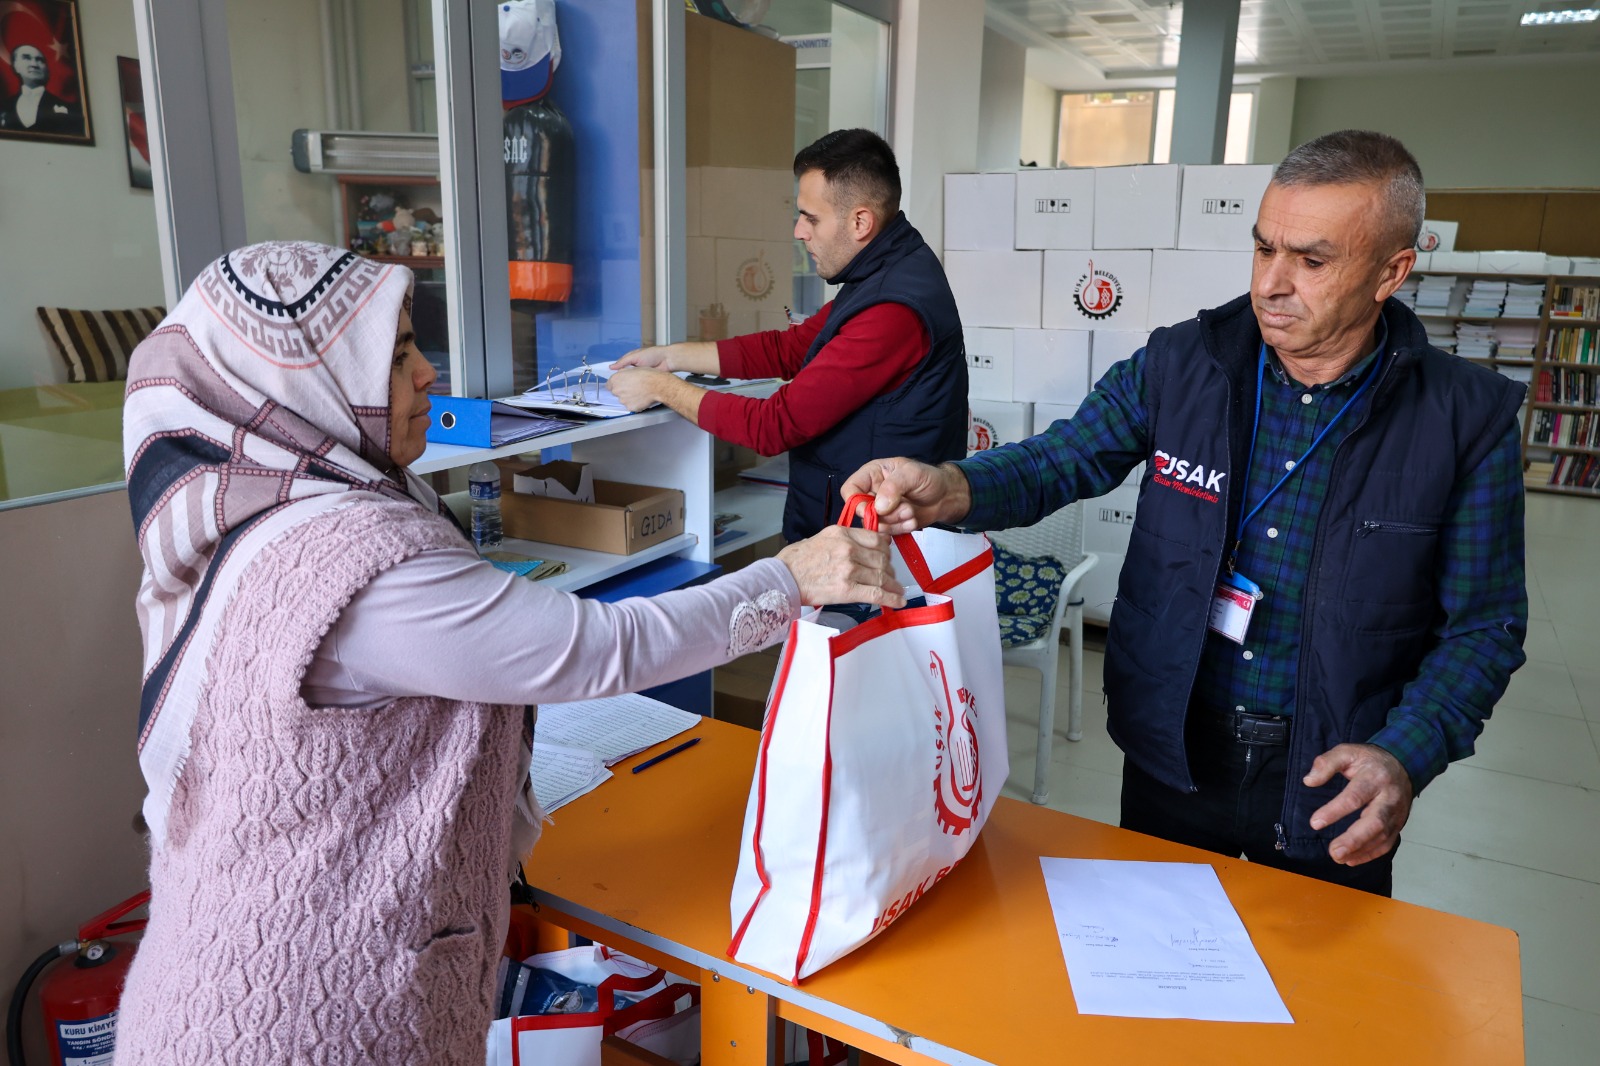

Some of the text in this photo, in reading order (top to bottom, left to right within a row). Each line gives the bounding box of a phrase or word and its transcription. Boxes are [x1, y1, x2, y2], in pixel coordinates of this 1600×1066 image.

[641, 510, 672, 537] GIDA
[64, 1019, 117, 1036] KURU KİMYE
